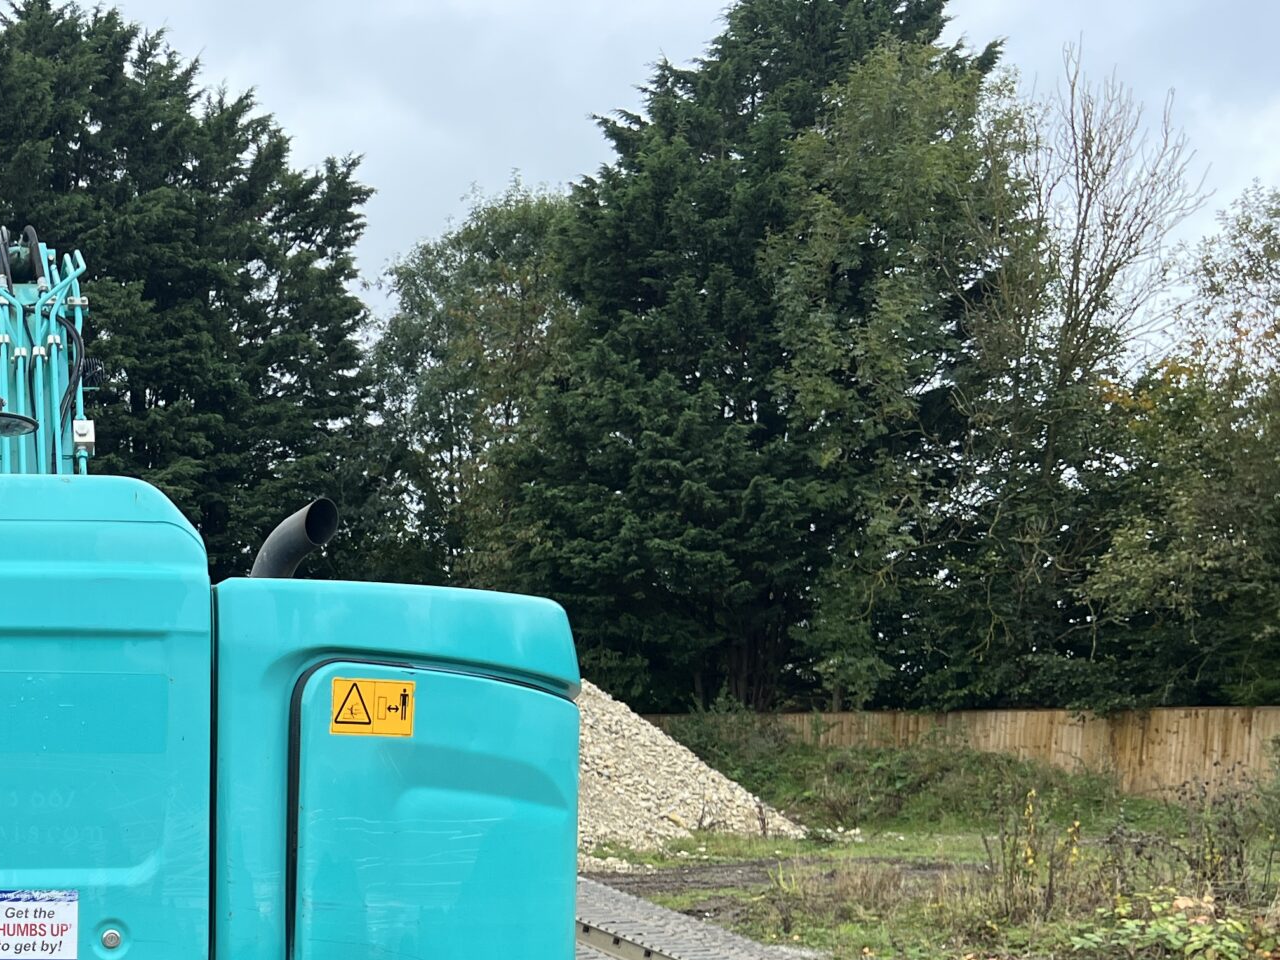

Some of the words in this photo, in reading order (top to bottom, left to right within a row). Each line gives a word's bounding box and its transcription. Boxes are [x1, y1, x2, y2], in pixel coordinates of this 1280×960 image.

[4, 907, 29, 919] Get
[33, 907, 55, 919] the
[14, 941, 37, 954] get
[40, 939, 62, 955] by!
